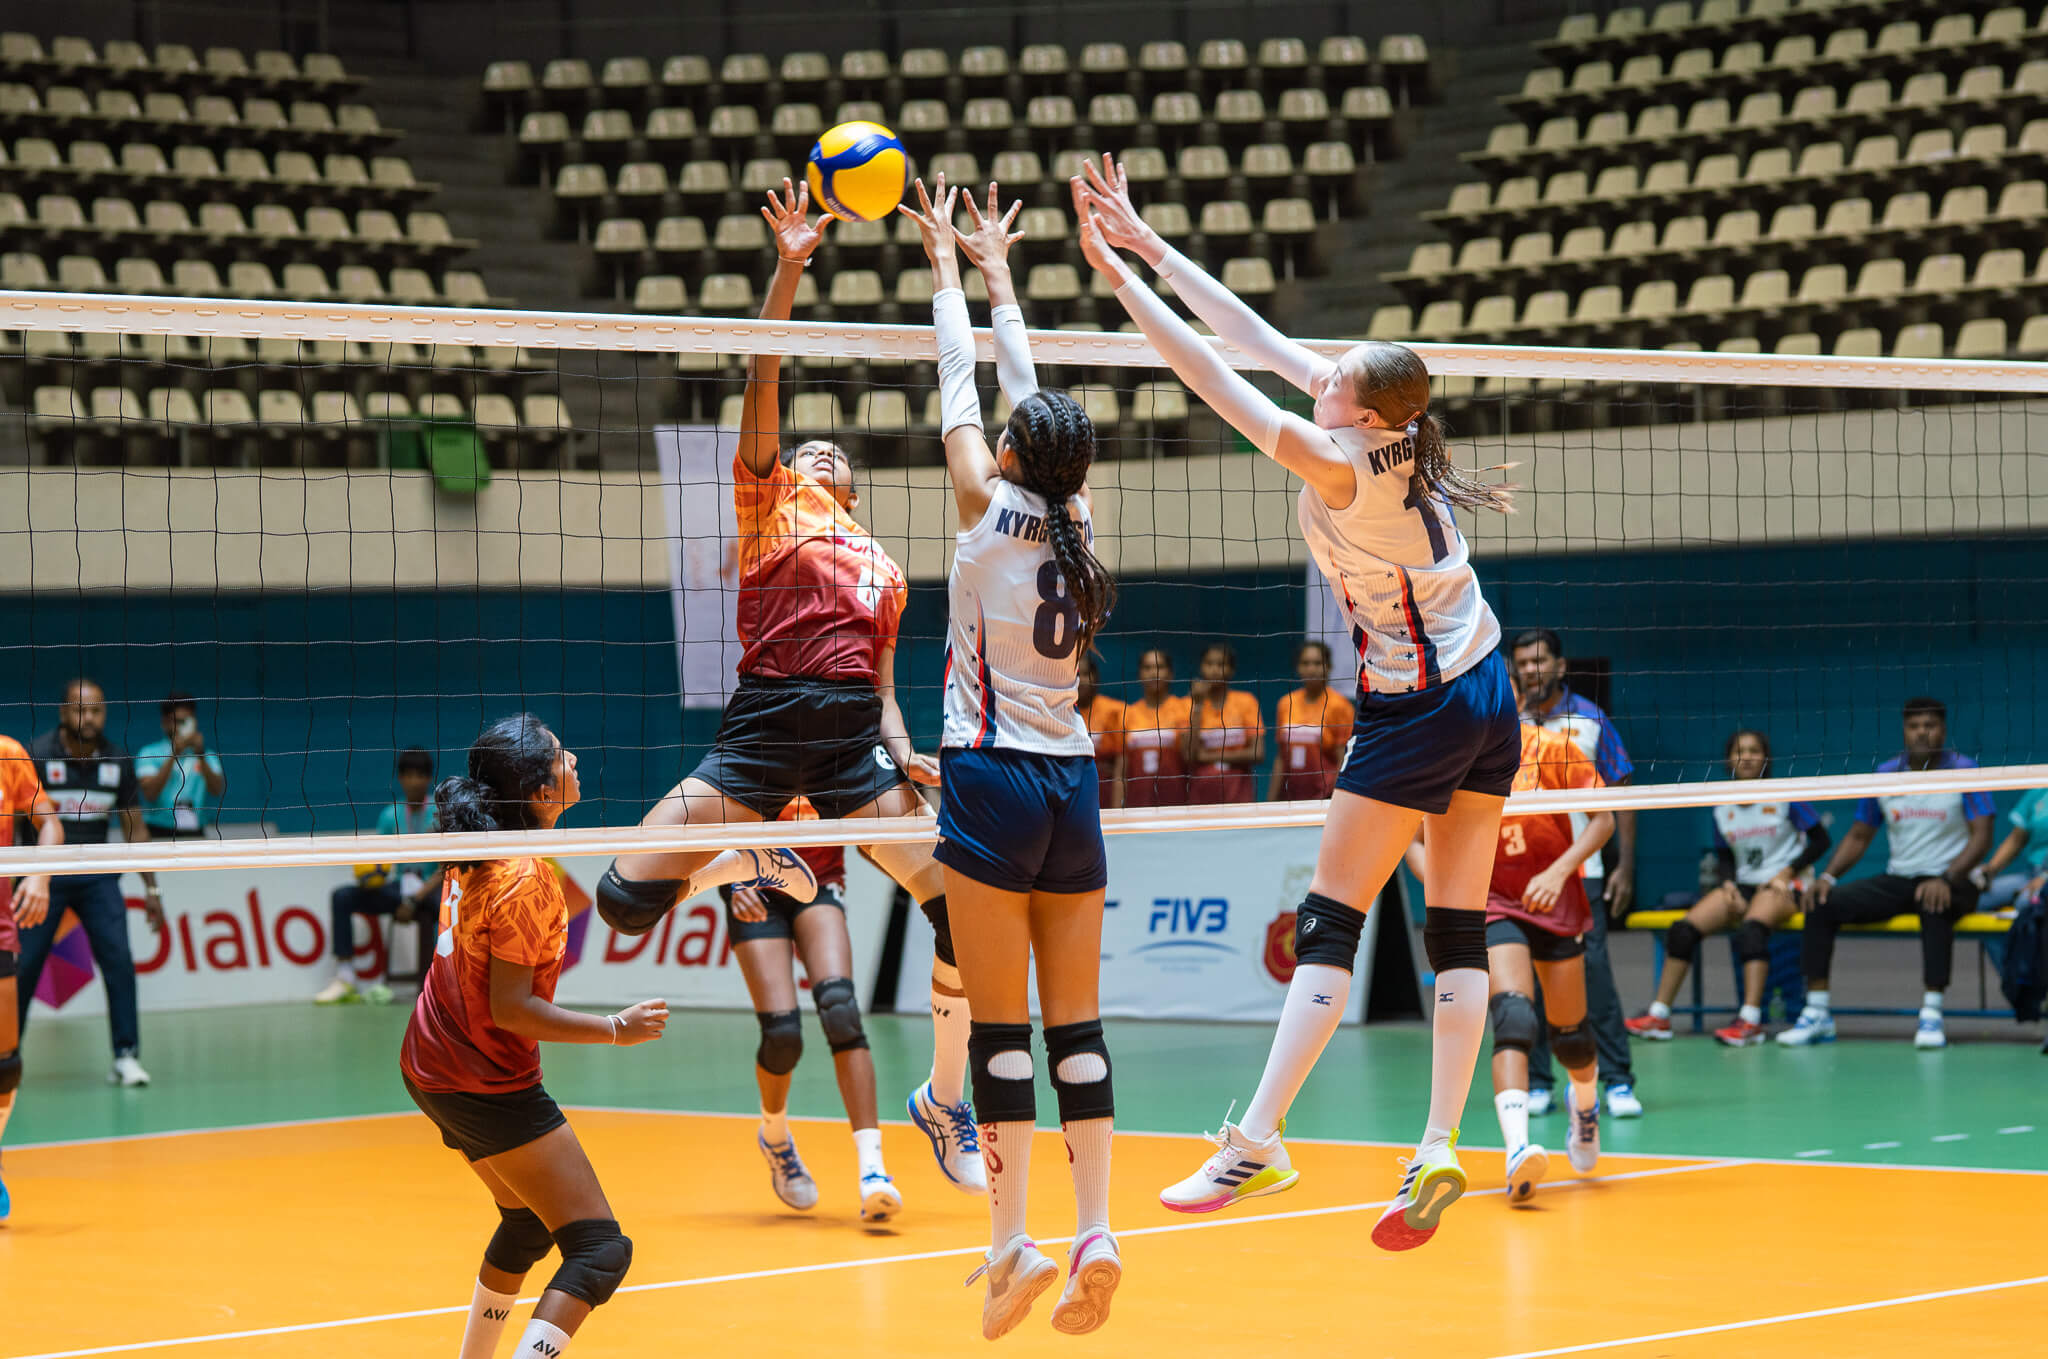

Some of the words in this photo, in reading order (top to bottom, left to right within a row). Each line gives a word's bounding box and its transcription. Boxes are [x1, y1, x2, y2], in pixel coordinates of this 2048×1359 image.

[1033, 559, 1081, 660] 8
[1501, 823, 1527, 857] 3
[1149, 898, 1230, 934] FIVB
